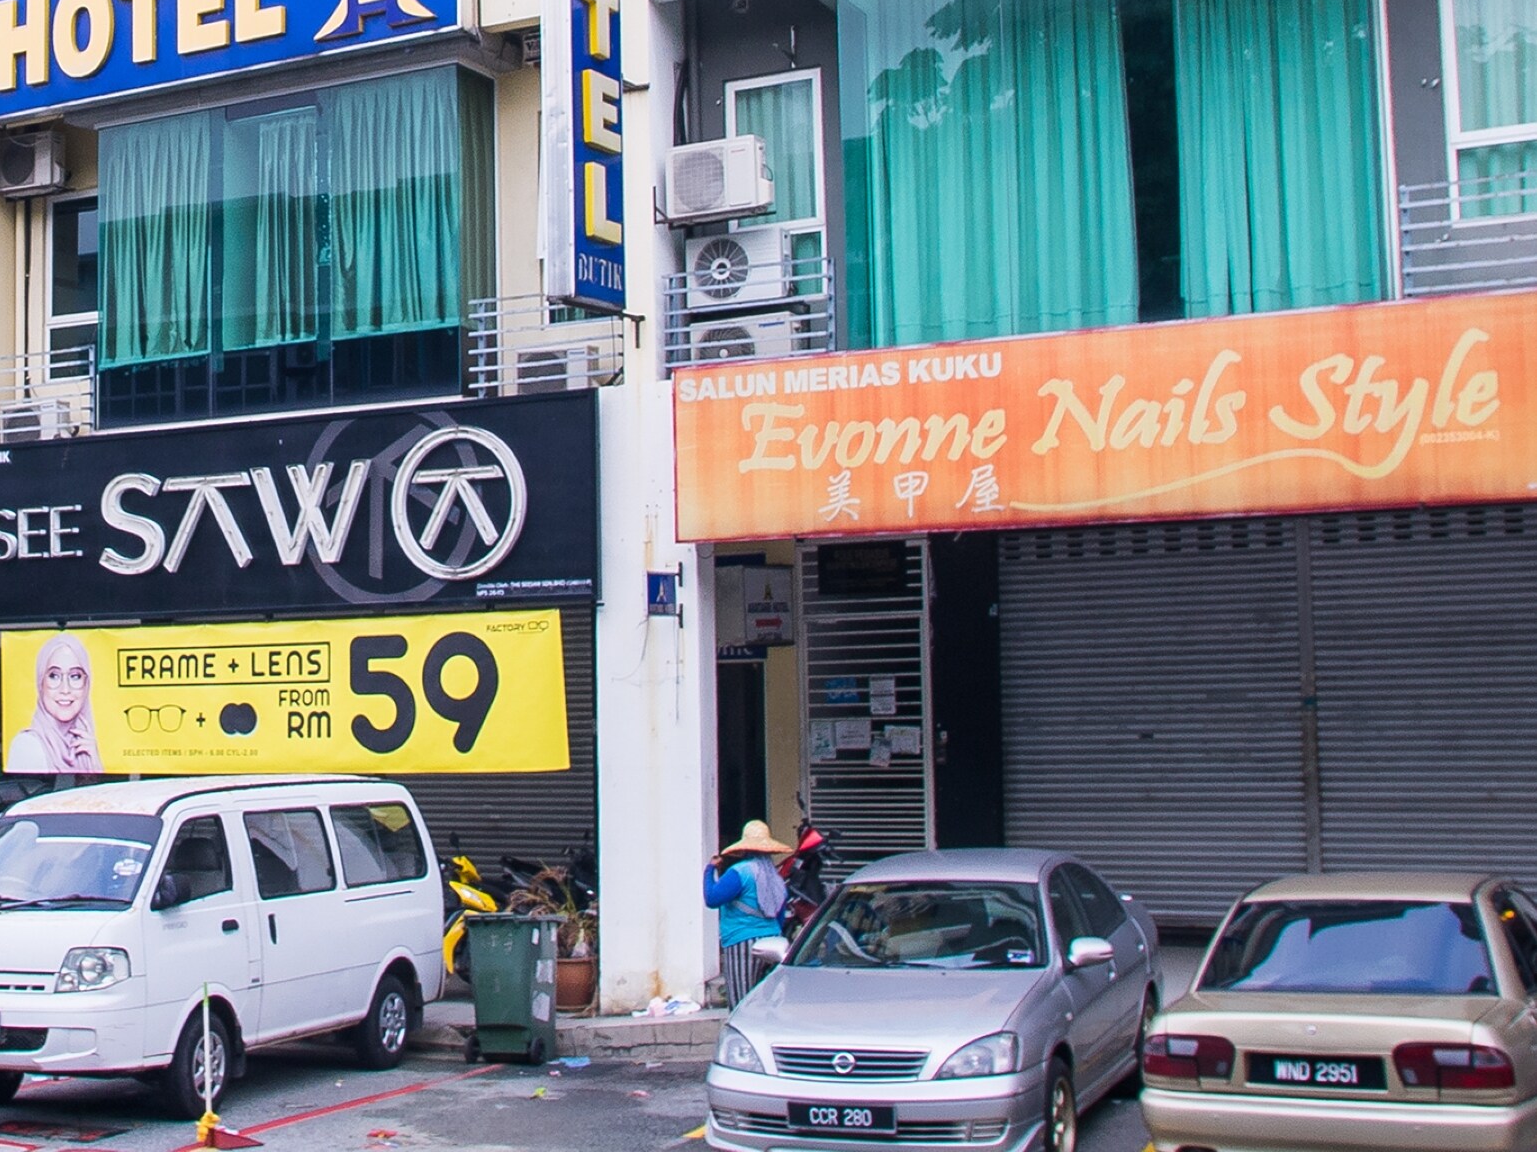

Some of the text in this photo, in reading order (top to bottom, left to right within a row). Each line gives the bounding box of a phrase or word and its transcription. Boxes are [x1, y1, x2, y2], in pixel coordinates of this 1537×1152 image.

[679, 351, 1002, 403] SALUN MERIAS KUKU
[738, 326, 1501, 479] Evonne Nails Style
[818, 464, 1006, 522] 美甲屋
[99, 458, 371, 575] SAW
[487, 623, 526, 633] FACTORY
[126, 654, 216, 680] FRAME
[251, 650, 322, 677] LENS
[278, 689, 330, 706] FROM
[350, 631, 499, 754] 59
[287, 711, 332, 739] RM
[122, 749, 160, 757] SELECTED
[1274, 1059, 1359, 1084] WND 2951
[809, 1107, 873, 1127] CCR 280
